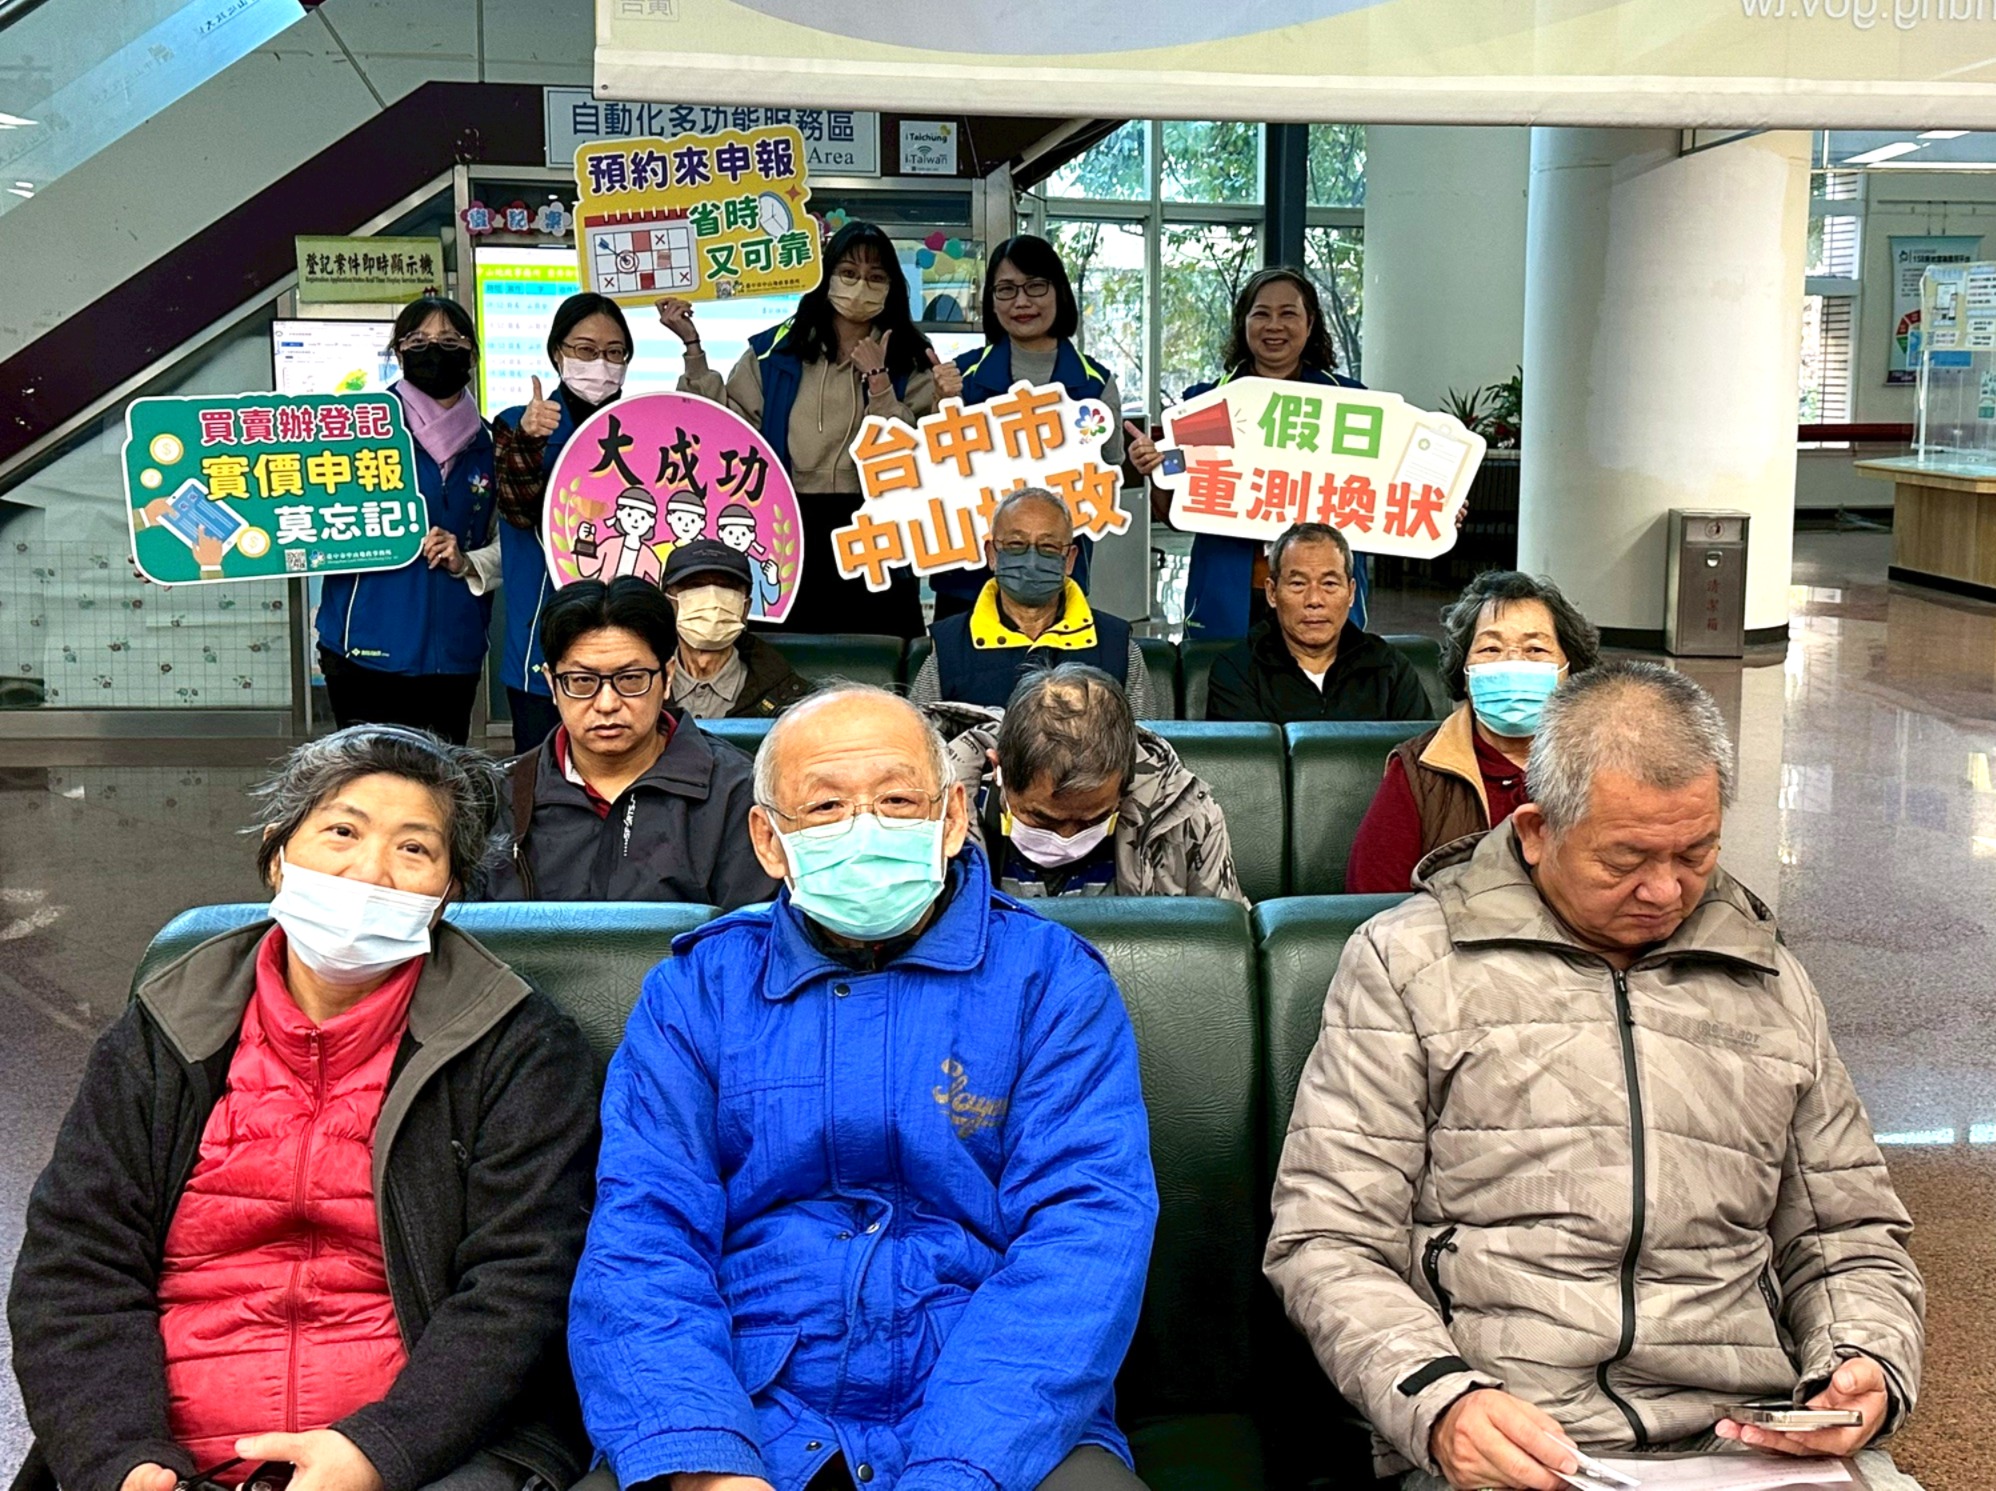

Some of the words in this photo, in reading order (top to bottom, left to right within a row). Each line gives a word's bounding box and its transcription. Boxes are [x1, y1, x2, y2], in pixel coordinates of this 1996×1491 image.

[571, 102, 855, 143] 自動化多功能服務區
[588, 138, 796, 194] 預約來申報
[807, 147, 855, 165] Area
[688, 195, 758, 237] 省時
[306, 252, 434, 276] 登記案件即時顯示機
[705, 231, 813, 279] 又可靠
[201, 405, 392, 443] 買賣辦登記
[854, 388, 1064, 498] 台中市
[1257, 391, 1384, 459] 假日
[202, 449, 404, 501] 實價申報
[589, 414, 769, 502] 大成功
[273, 500, 419, 544] 莫忘記!
[1182, 459, 1445, 541] 重測換狀
